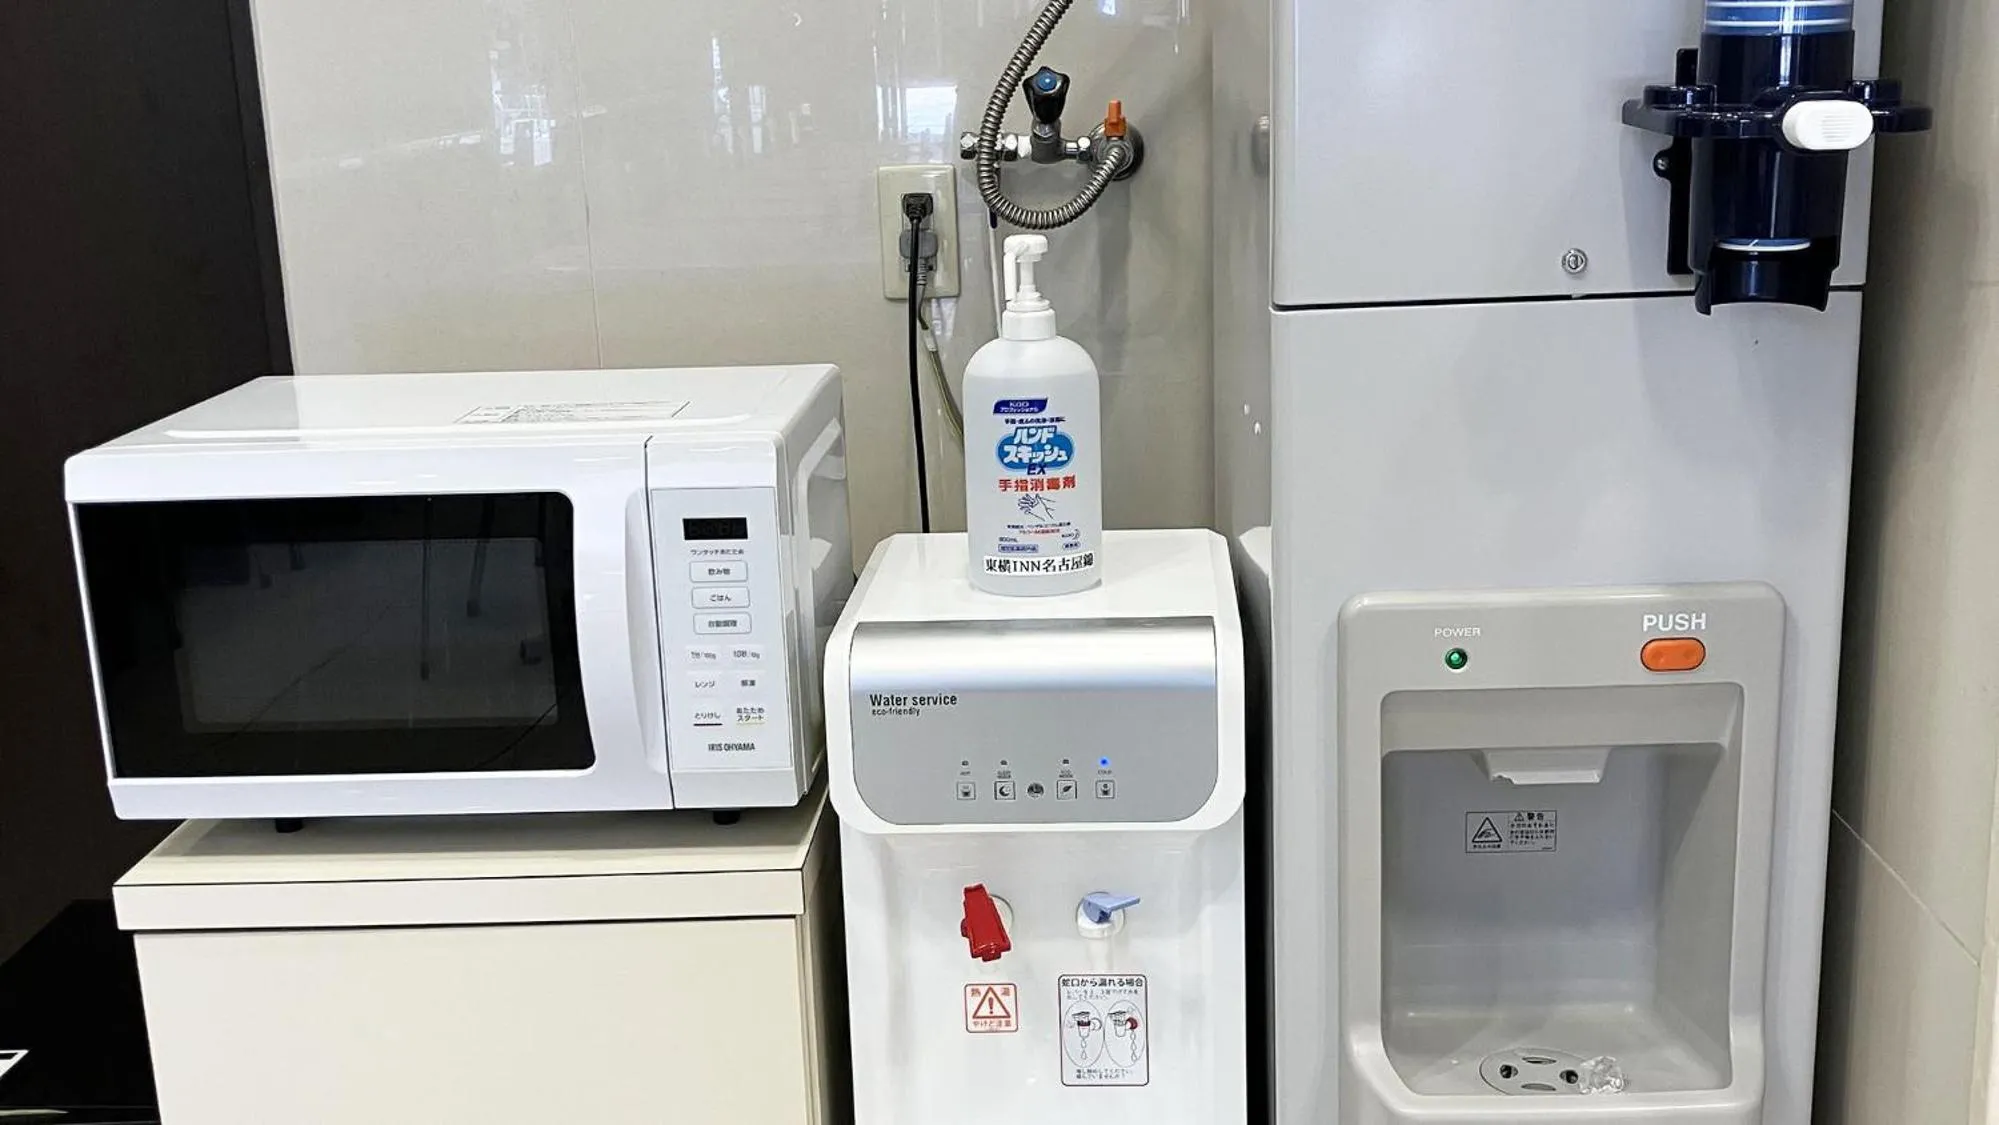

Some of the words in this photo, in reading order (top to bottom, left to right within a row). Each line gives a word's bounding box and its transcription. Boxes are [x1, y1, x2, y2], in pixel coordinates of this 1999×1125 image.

[1013, 426, 1055, 445] ハンド
[1003, 443, 1069, 464] スキッシュ
[1027, 463, 1048, 475] EX
[998, 474, 1076, 492] 手指消毒剤
[709, 594, 732, 602] ごはん
[1642, 612, 1708, 632] PUSH
[1433, 627, 1482, 638] POWER
[694, 680, 716, 689] レンジ
[869, 693, 908, 706] Water
[911, 692, 957, 706] service
[694, 711, 722, 720] とりけし
[871, 706, 921, 717] eco-friendly
[737, 714, 765, 722] スタート
[707, 743, 723, 752] IRIS
[724, 742, 756, 752] OHYAMA
[1061, 977, 1144, 988] 蛇口から漏れる場合
